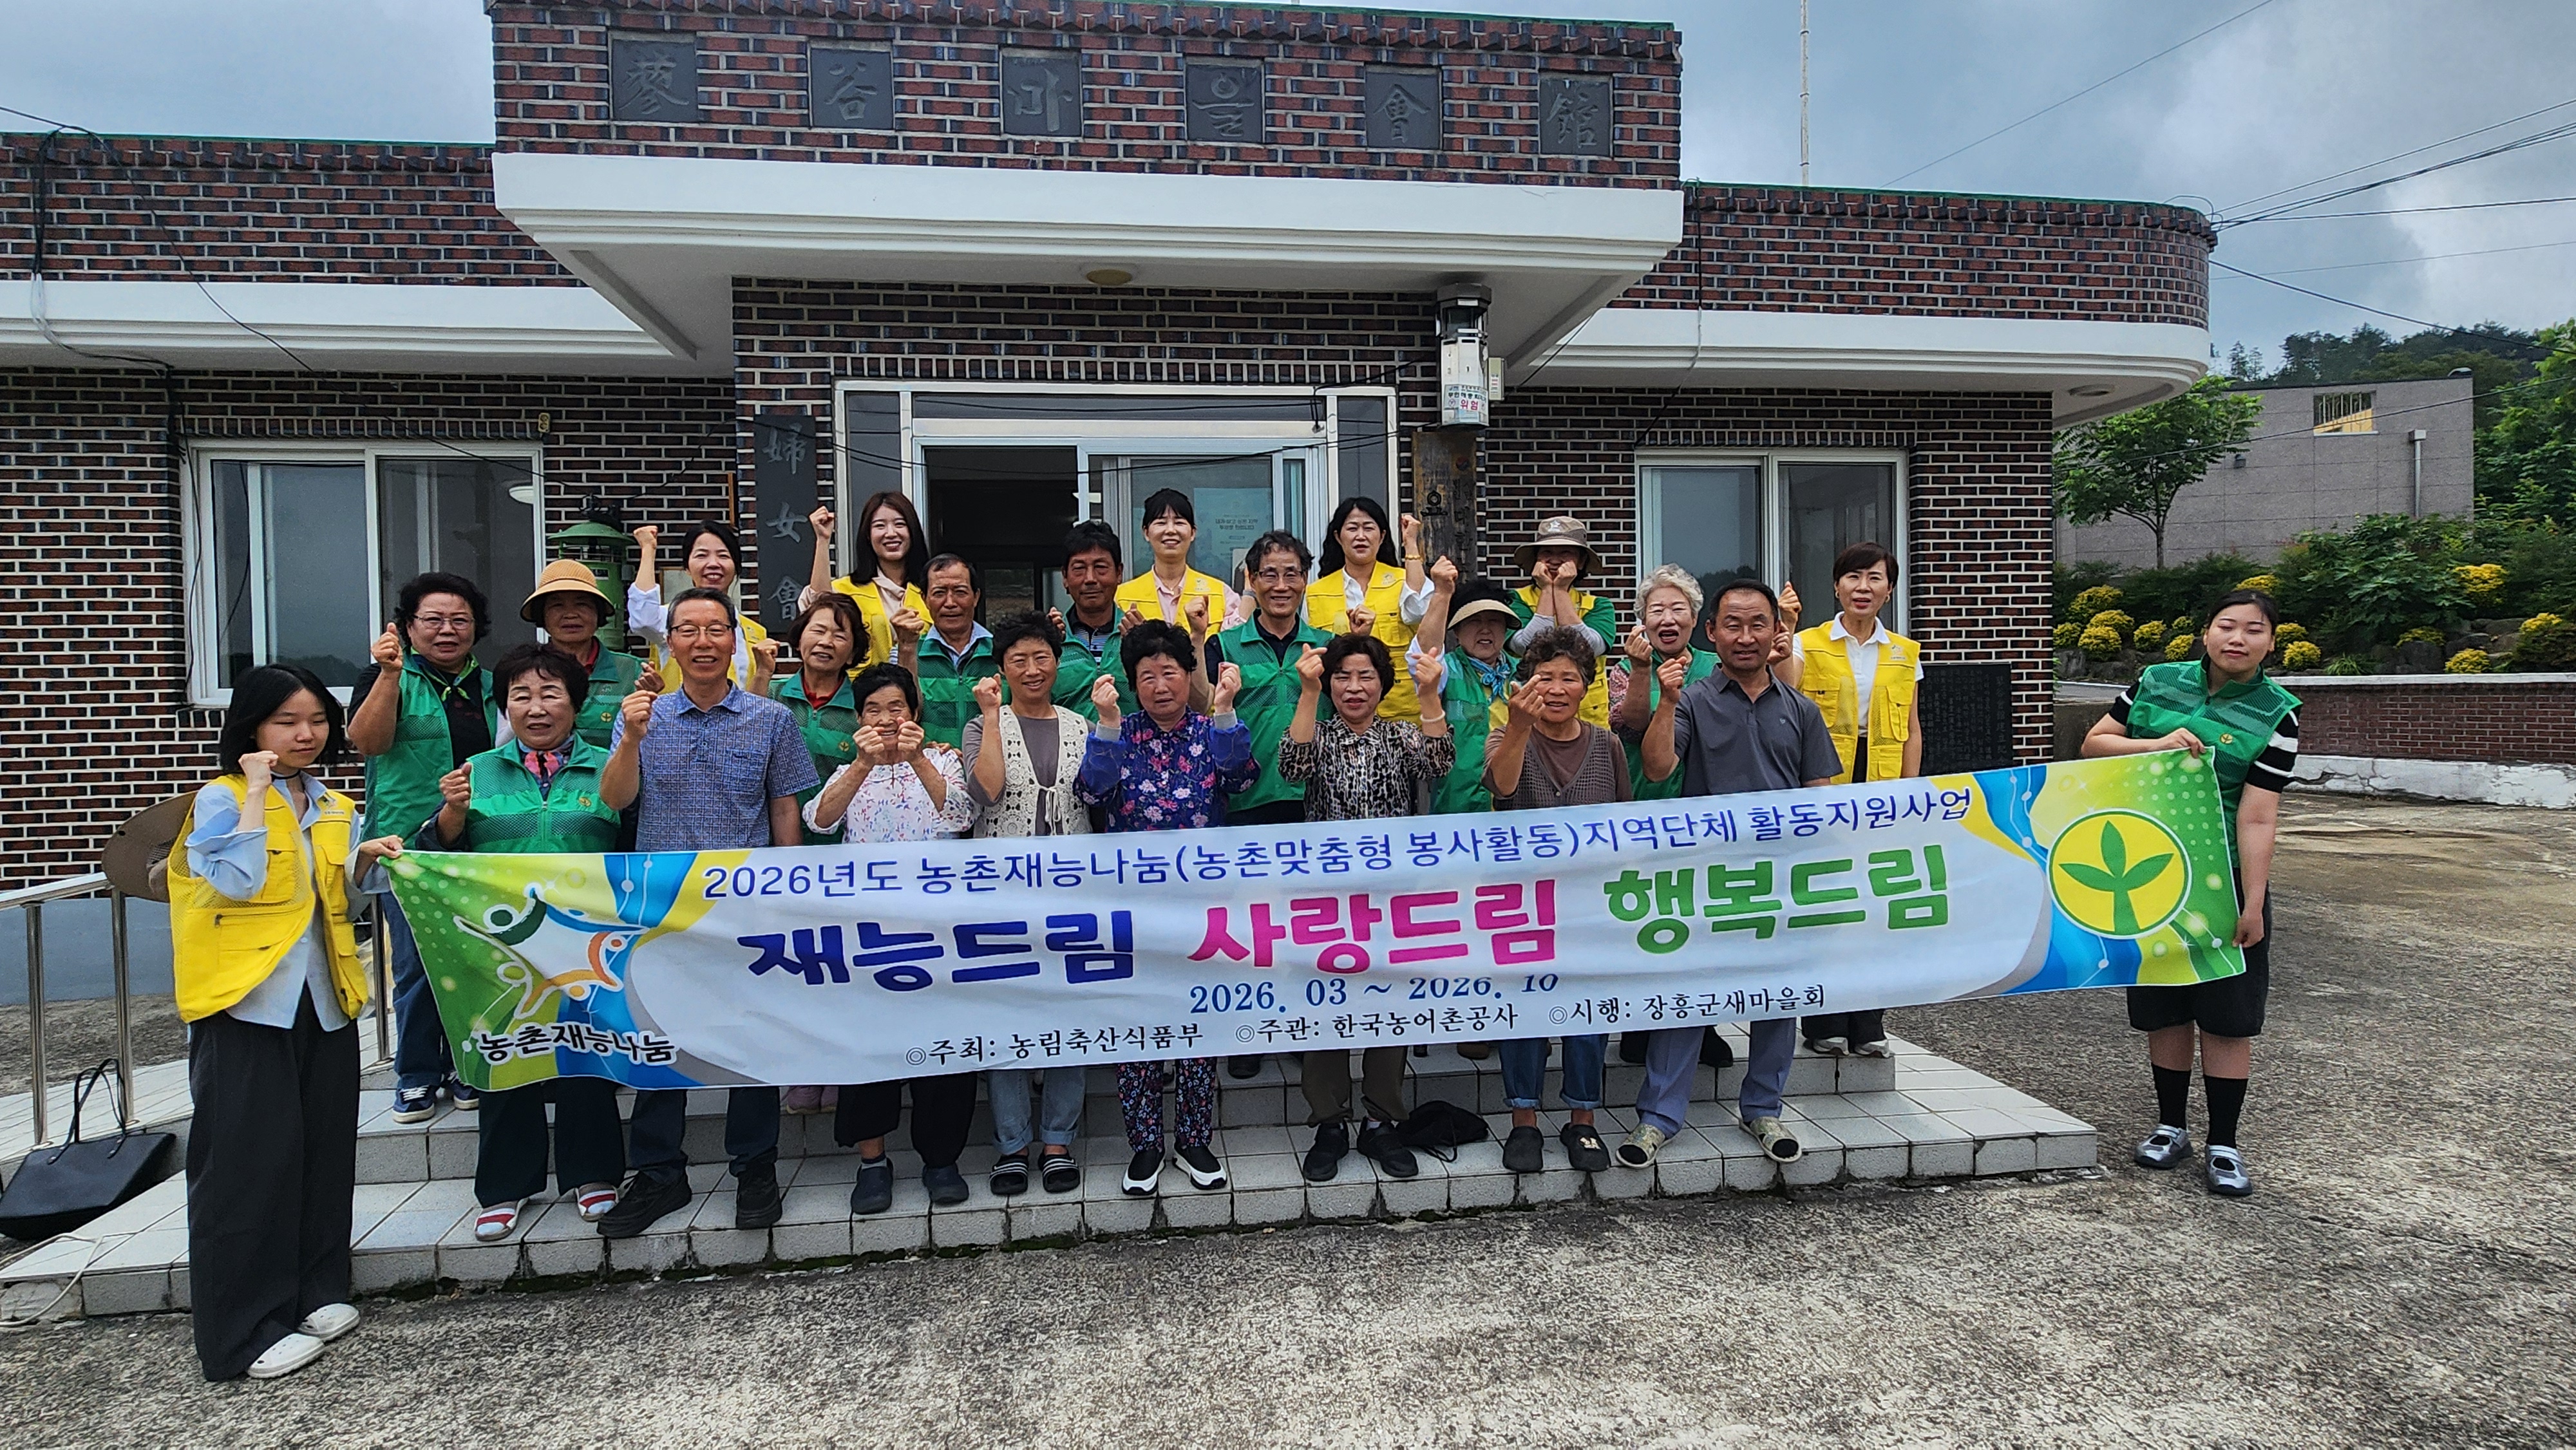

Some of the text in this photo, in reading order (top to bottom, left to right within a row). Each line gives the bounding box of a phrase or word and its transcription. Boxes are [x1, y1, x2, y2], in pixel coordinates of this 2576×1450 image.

[762, 422, 808, 621] 婦女會
[704, 787, 1971, 899] 2026년도 농촌재능나눔(농촌맞춤형 봉사활동)지역단체 활동지원사업
[735, 843, 1949, 992] 재능드림 사랑드림 행복드림
[1008, 1022, 1204, 1060] 농림축산식품부
[1331, 1003, 1519, 1039] 한국농어촌공사
[1642, 984, 1825, 1021] 장흥군새마을회
[1189, 981, 1287, 1014] 2026.
[1305, 977, 1347, 1006] 03
[1408, 975, 1502, 1001] 2026.
[1521, 973, 1560, 993] 10
[478, 1024, 675, 1065] 농촌재능나눔
